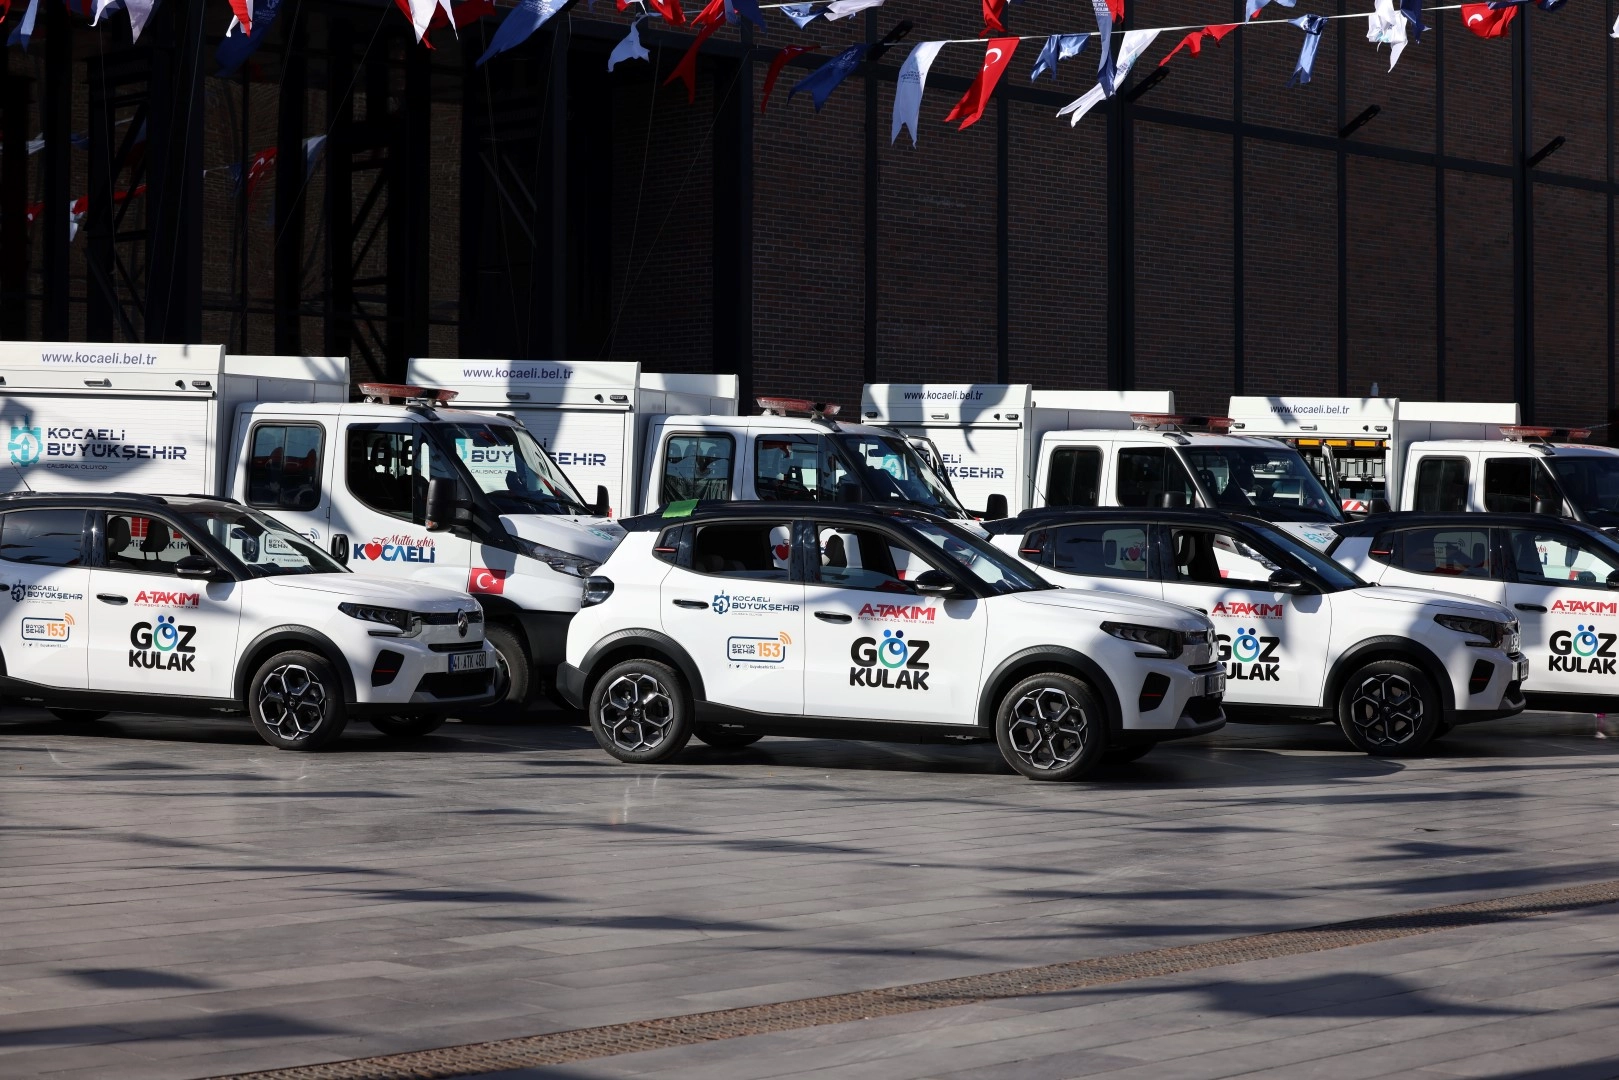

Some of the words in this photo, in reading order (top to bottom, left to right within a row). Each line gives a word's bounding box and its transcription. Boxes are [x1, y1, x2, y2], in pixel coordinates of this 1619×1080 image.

[41, 351, 157, 366] www.kocaeli.bel.tr
[463, 367, 573, 380] www.kocaeli.bel.tr
[904, 390, 984, 401] www.kocaeli.bel.tr
[1270, 404, 1350, 415] www.kocaeli.bel.tr
[858, 603, 936, 621] A-TAKIMI
[46, 623, 66, 637] 153
[130, 615, 197, 653] GÖZ
[757, 642, 781, 657] 153
[850, 629, 930, 670] GÖZ
[1216, 627, 1280, 663] GÖZ
[1549, 624, 1617, 658] GÖZ
[129, 649, 196, 672] KULAK
[1549, 655, 1617, 675] KULAK
[850, 667, 930, 690] KULAK
[1221, 662, 1280, 681] ULAK
